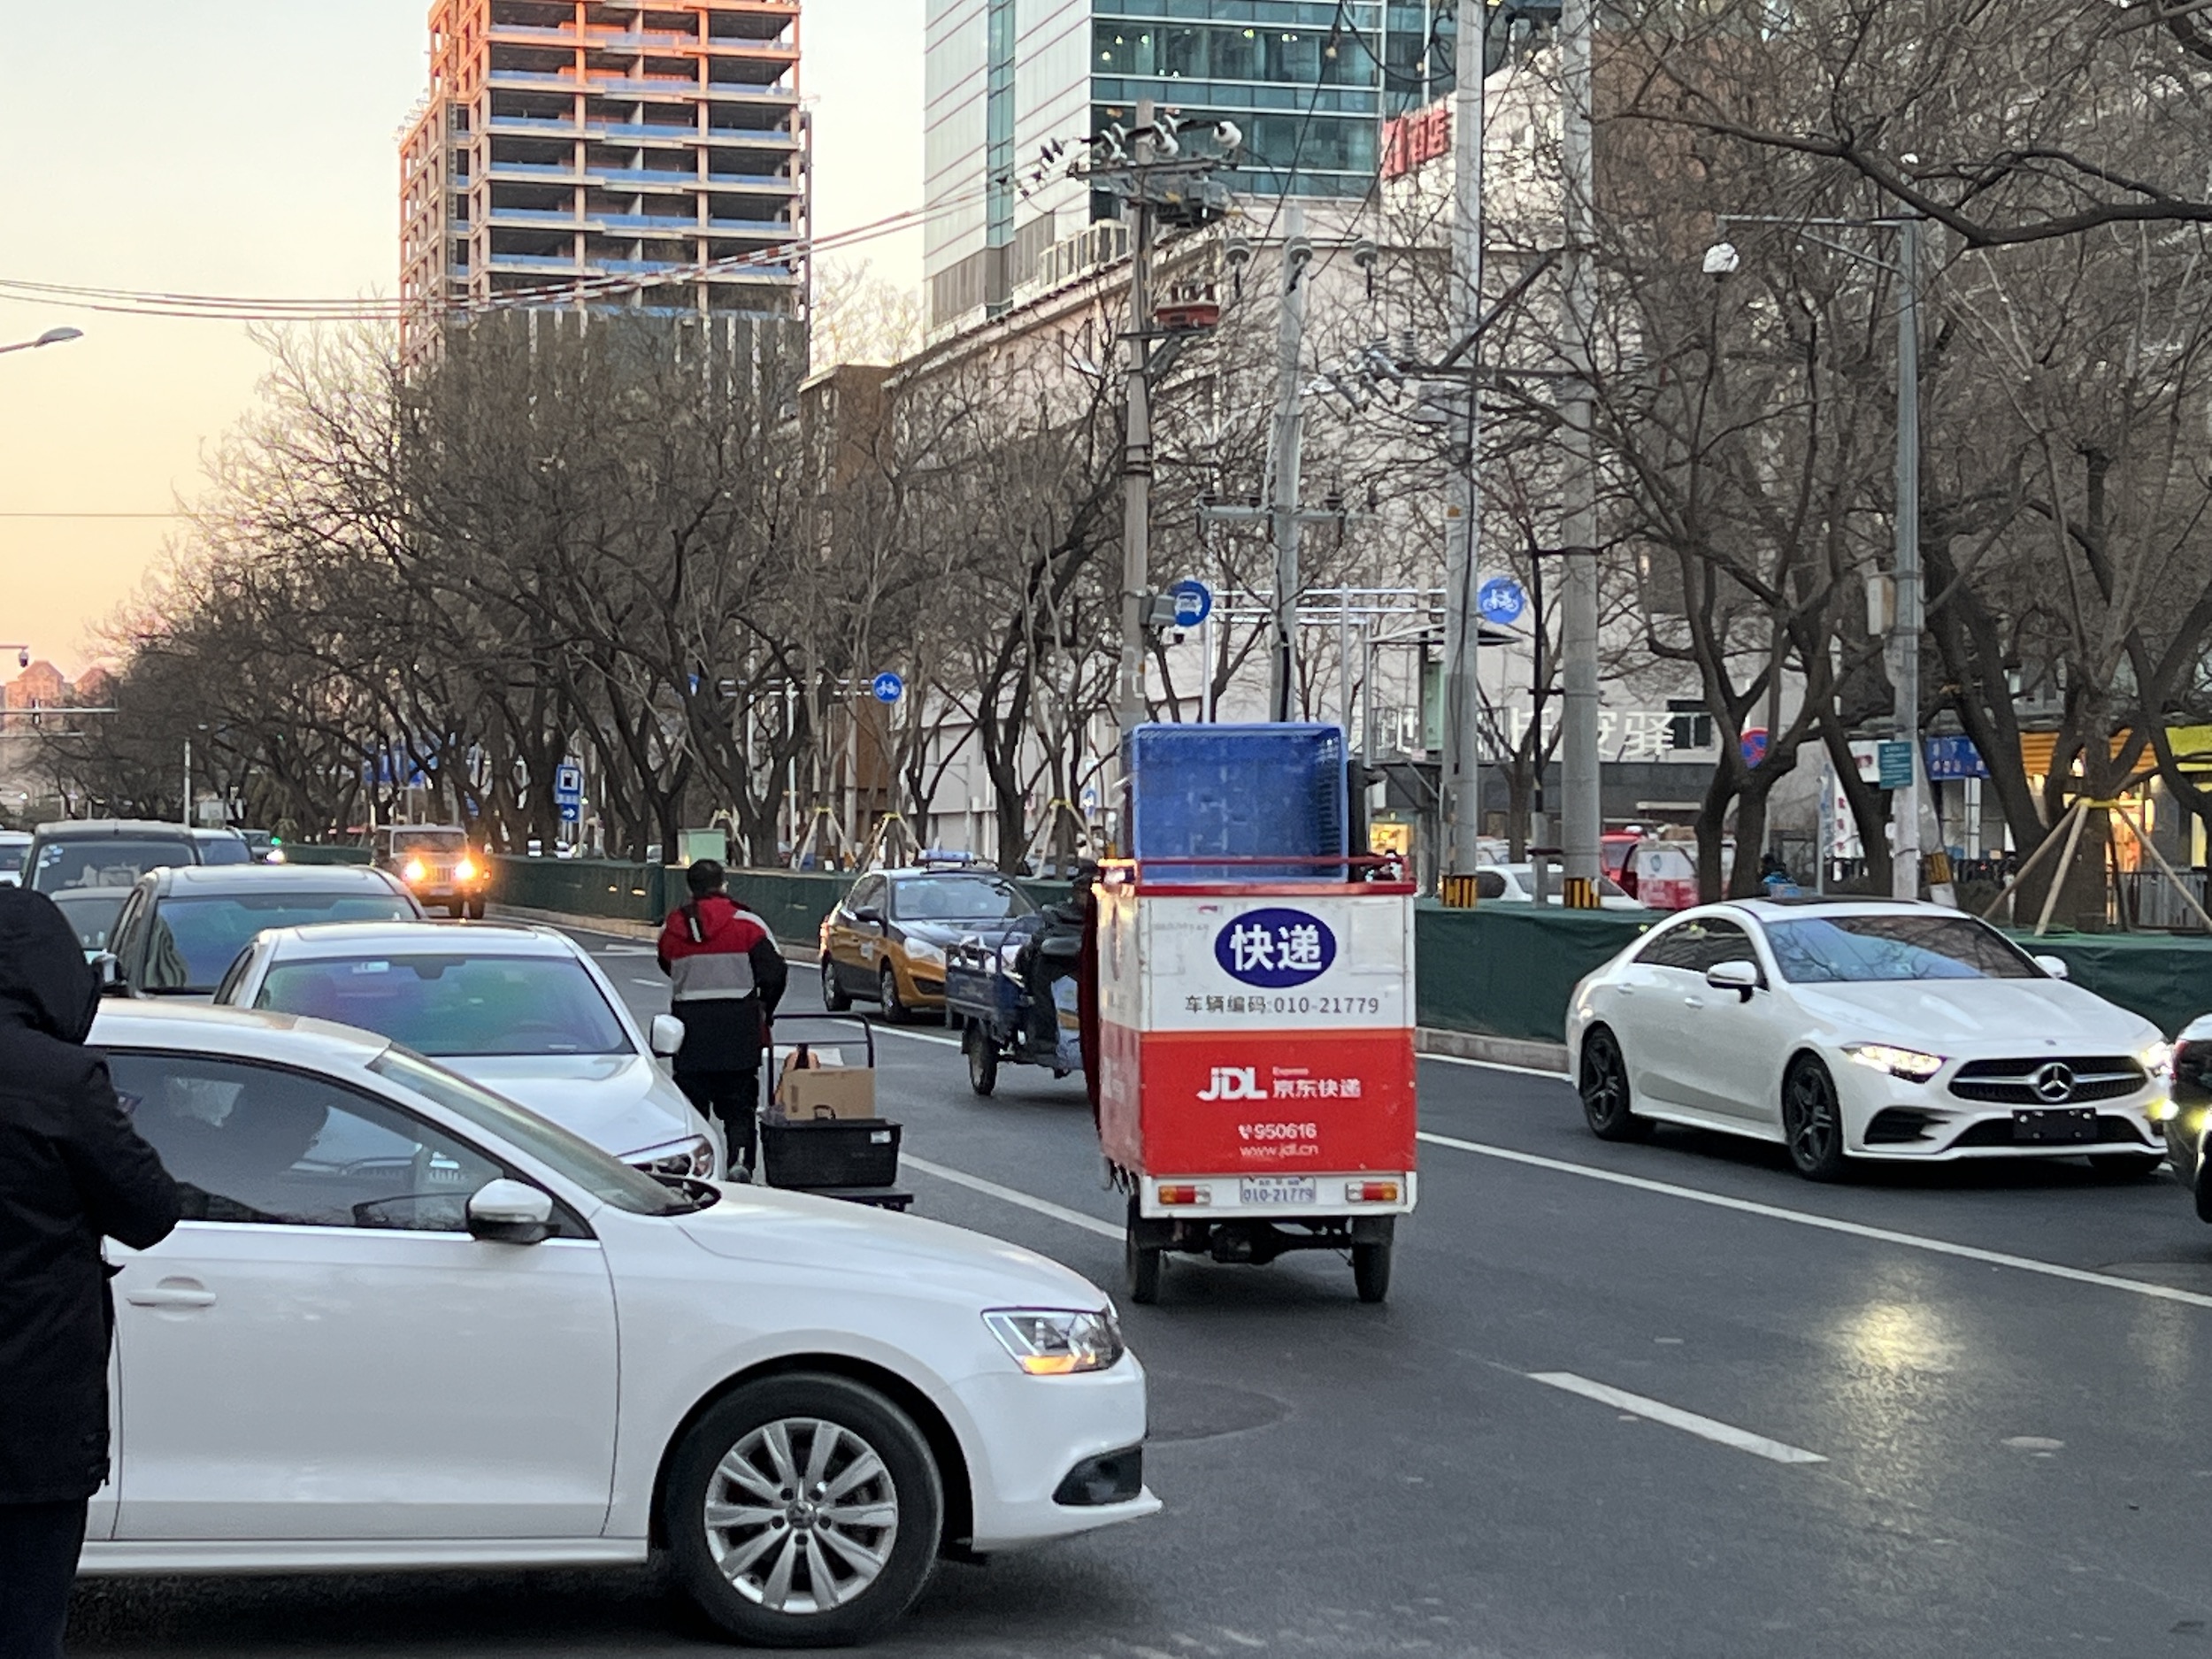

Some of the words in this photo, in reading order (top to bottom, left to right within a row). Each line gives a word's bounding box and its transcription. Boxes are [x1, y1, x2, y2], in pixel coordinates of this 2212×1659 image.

[1229, 923, 1322, 972] 快递
[1185, 995, 1379, 1014] 车辆编码:010-21779
[1195, 1066, 1268, 1101] JDL
[1272, 1078, 1362, 1098] 京东快递
[1253, 1122, 1317, 1140] 950616
